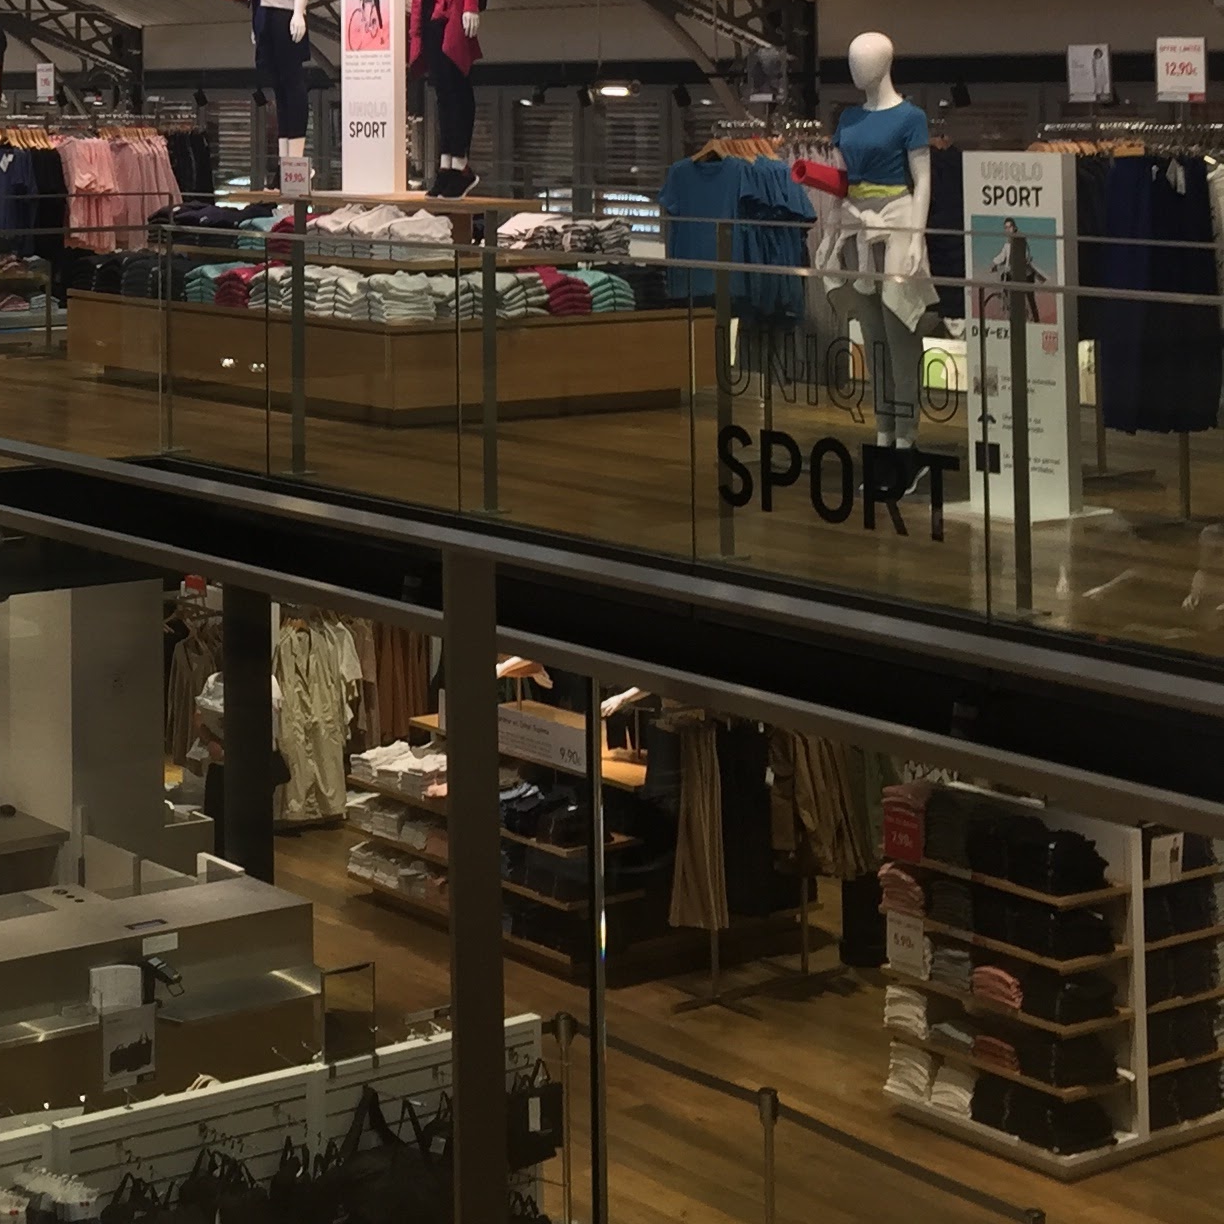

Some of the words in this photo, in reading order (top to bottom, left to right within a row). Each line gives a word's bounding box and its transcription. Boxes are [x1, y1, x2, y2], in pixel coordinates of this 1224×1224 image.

[349, 121, 387, 138] SPORT
[980, 160, 1043, 182] UNIQLO
[981, 184, 1043, 208] SPORT
[971, 325, 1011, 340] DY-EX
[715, 326, 959, 424] UNIQLO
[717, 424, 960, 543] SPORT
